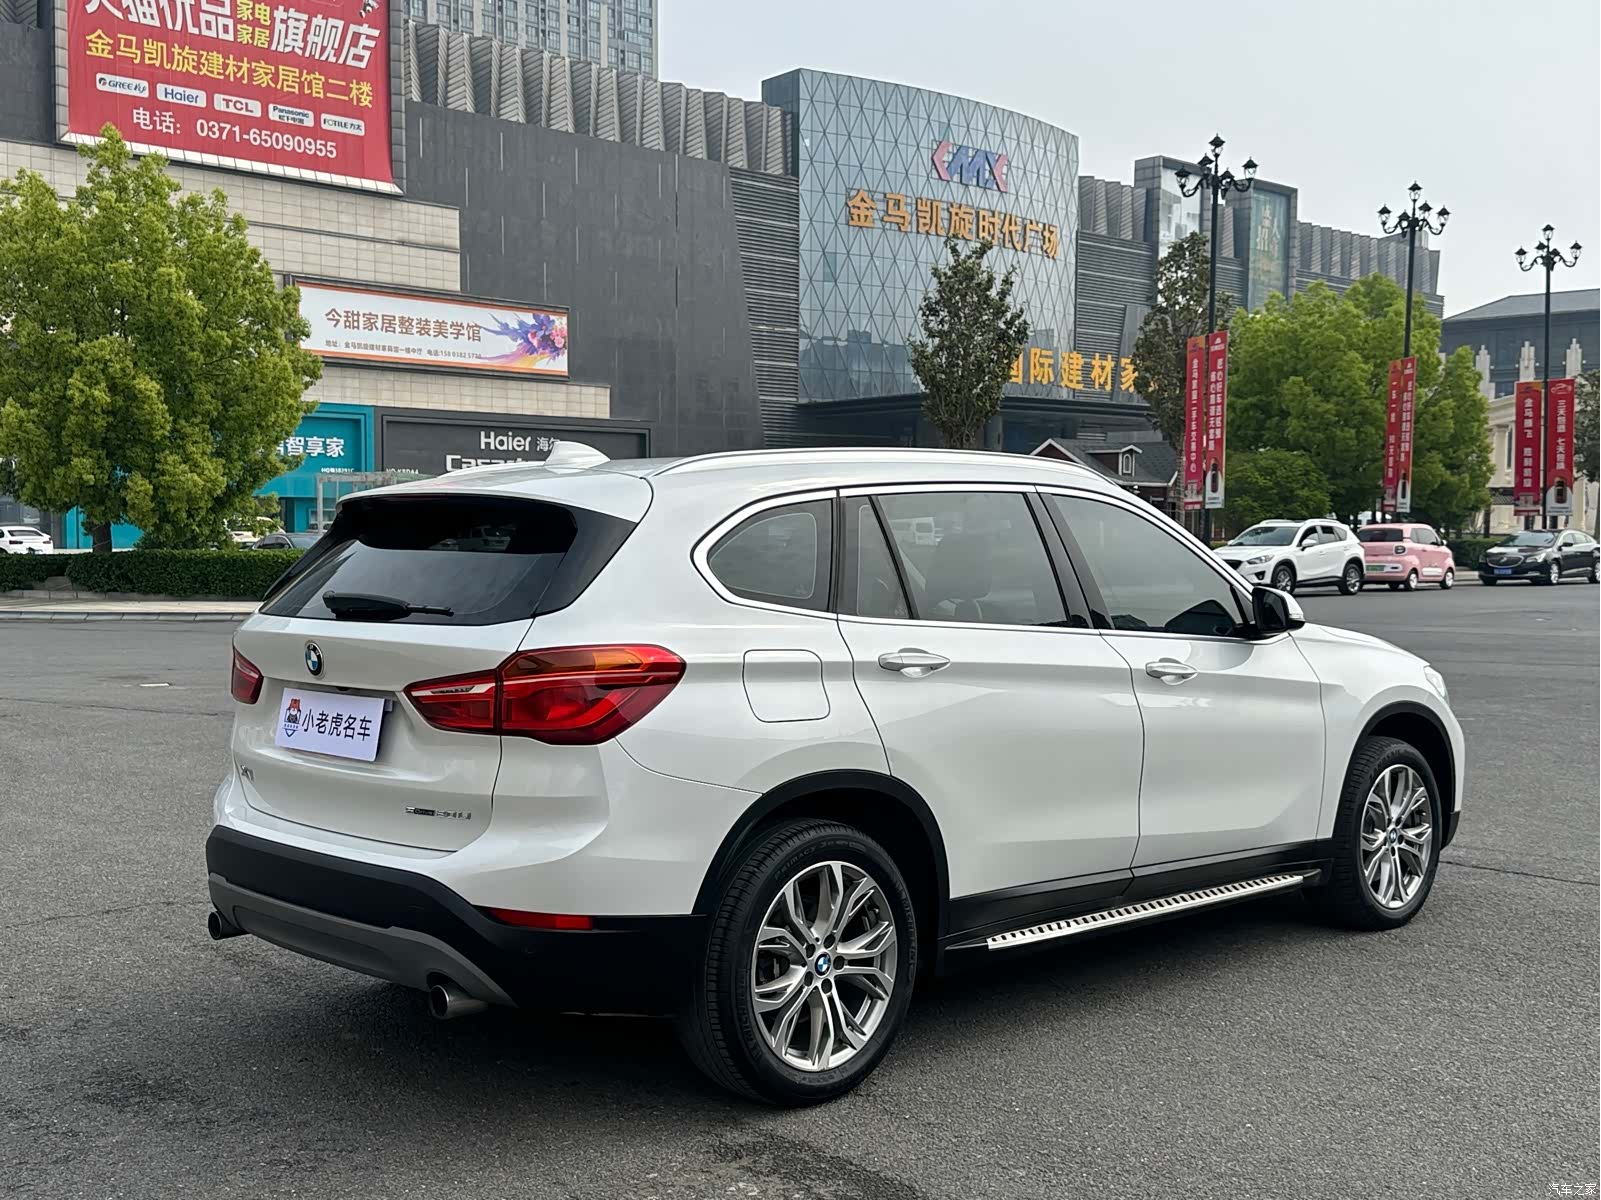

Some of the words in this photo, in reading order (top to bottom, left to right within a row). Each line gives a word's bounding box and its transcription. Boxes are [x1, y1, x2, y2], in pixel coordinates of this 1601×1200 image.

[237, 0, 271, 25] 家电
[237, 24, 270, 48] 家居
[271, 5, 380, 69] 旗舰店
[86, 29, 373, 108] 金马凯旋建材家居馆二楼
[164, 87, 199, 104] Haier
[222, 98, 254, 113] TCL
[273, 105, 310, 118] Panasonic
[196, 119, 337, 158] 0371-65090955
[847, 188, 1059, 260] 金马凯旋时代广场
[325, 308, 481, 342] 今甜家居整装美学馆
[480, 431, 531, 451] Haier
[302, 708, 372, 741] 小老虎名车
